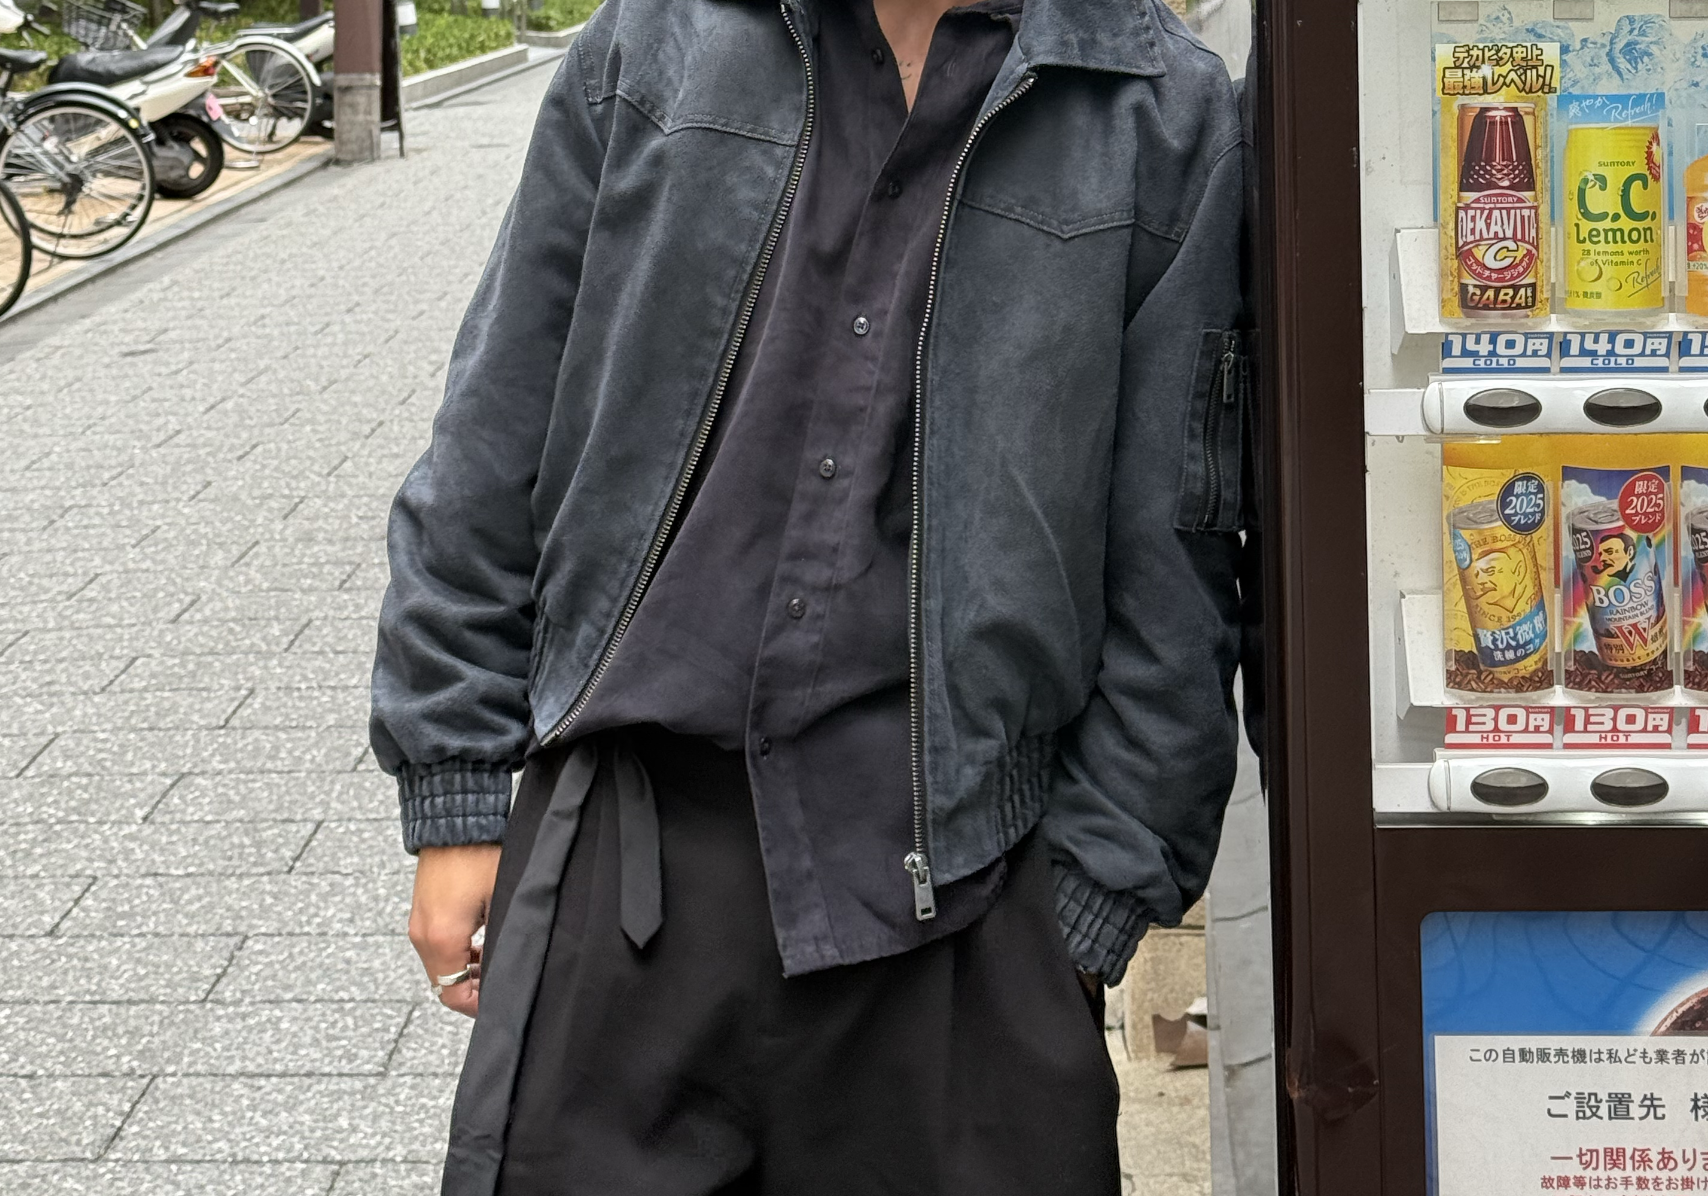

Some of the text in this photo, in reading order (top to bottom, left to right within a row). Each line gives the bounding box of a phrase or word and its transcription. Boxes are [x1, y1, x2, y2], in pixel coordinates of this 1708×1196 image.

[1453, 44, 1544, 67] デカビタ史上
[1442, 65, 1554, 96] 最強レベル!
[1577, 172, 1657, 223] C.C.
[1458, 208, 1537, 246] DEKAVITA
[1574, 222, 1654, 245] Lemon
[1483, 239, 1518, 269] C
[1589, 258, 1642, 266] of Vitamin C
[1593, 249, 1625, 257] lemons
[1627, 247, 1650, 256] worth
[1467, 286, 1526, 307] GABA
[1448, 333, 1549, 356] 140円
[1566, 333, 1668, 355] 140円
[1687, 333, 1708, 355] 1
[1472, 358, 1516, 366] COLD
[1590, 357, 1635, 366] COLD
[1514, 480, 1539, 495] 限定
[1634, 479, 1659, 494] 限定
[1504, 494, 1544, 514] 2025
[1625, 494, 1664, 514] 2025
[1510, 513, 1541, 525] ブレンド
[1631, 513, 1662, 525] ブレンド
[1572, 531, 1591, 550] 025
[1590, 571, 1655, 608] BOSS
[1605, 613, 1639, 622] MOUNTAIN
[1609, 600, 1649, 615] RAINBOW
[1611, 615, 1652, 653] W
[1452, 707, 1550, 732] 130円
[1570, 707, 1670, 732] 130円
[1480, 734, 1513, 742] HOT
[1599, 734, 1631, 742] HOT
[1469, 1046, 1708, 1065] この自動販売機は私ども業者が
[1546, 1090, 1666, 1121] ご設置先
